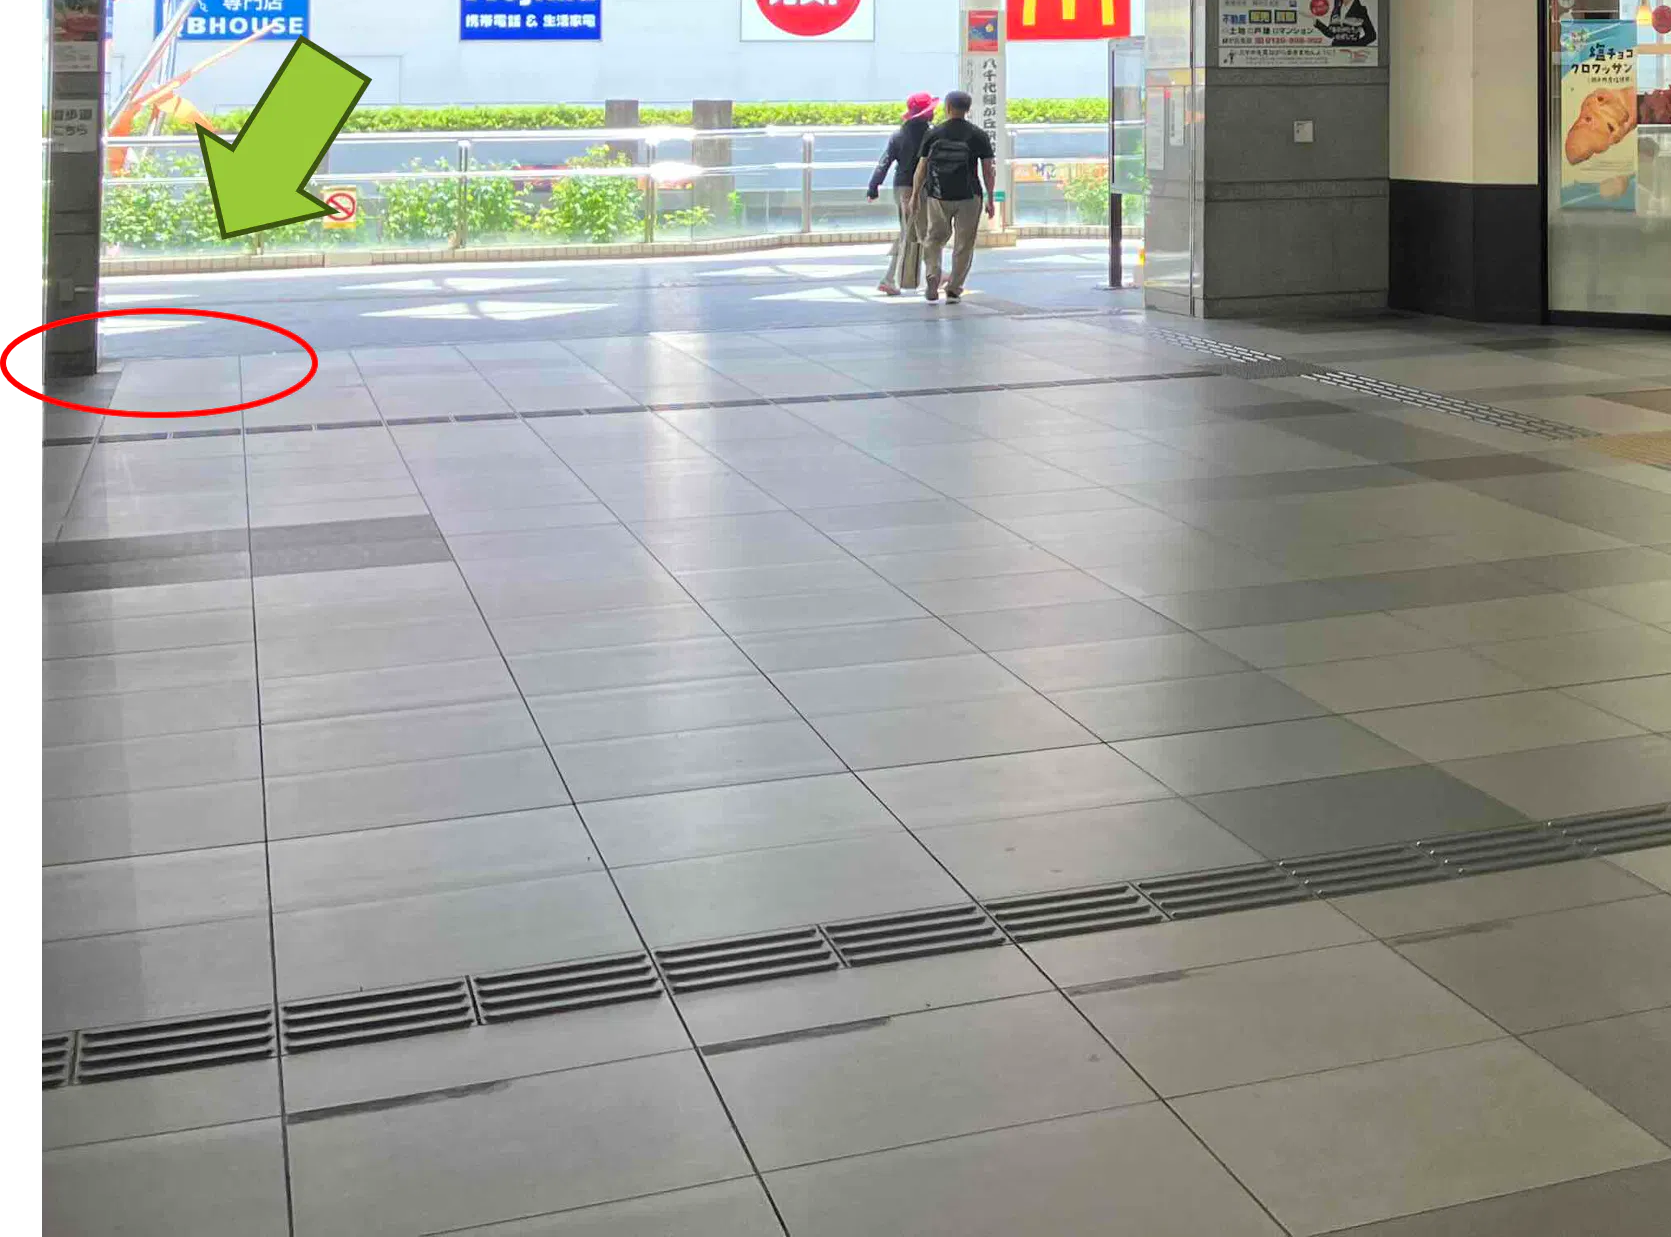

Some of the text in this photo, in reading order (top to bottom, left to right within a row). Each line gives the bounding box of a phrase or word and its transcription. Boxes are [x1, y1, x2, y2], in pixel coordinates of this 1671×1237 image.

[180, 16, 304, 36] BHOUSE
[465, 14, 522, 29] 携帯電話
[1589, 43, 1634, 62] 塩チョコ
[1570, 62, 1633, 75] クロワッサン
